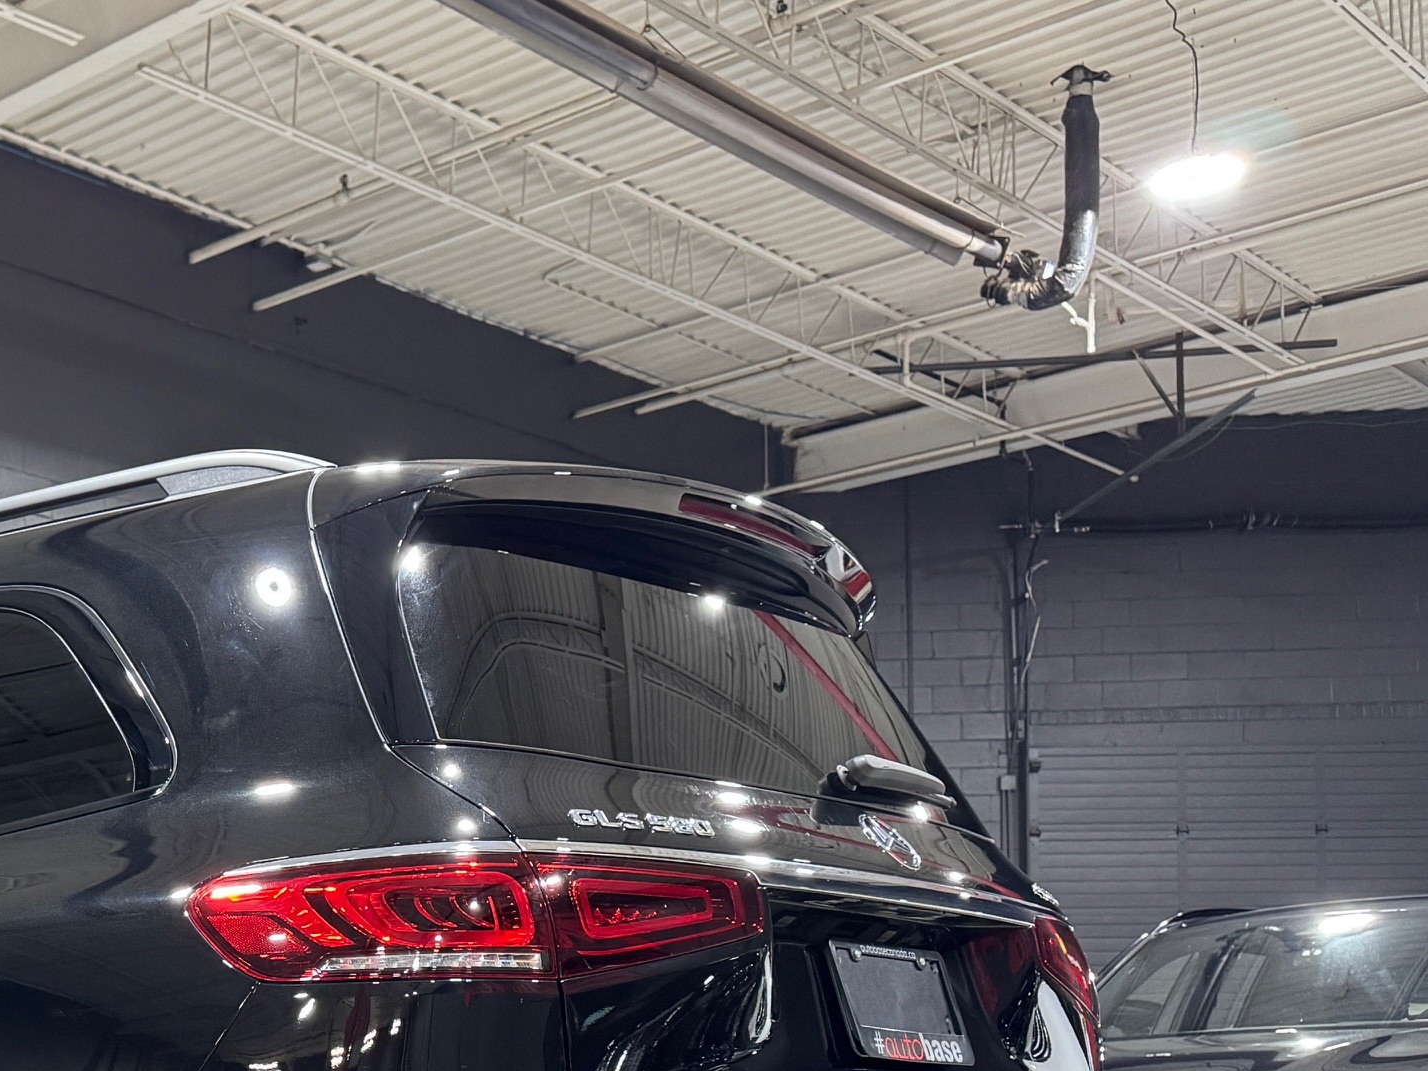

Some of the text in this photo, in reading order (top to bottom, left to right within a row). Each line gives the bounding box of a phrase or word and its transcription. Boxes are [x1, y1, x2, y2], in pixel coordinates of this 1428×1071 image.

[567, 809, 716, 837] GLS 580
[874, 1030, 963, 1063] #autobase
